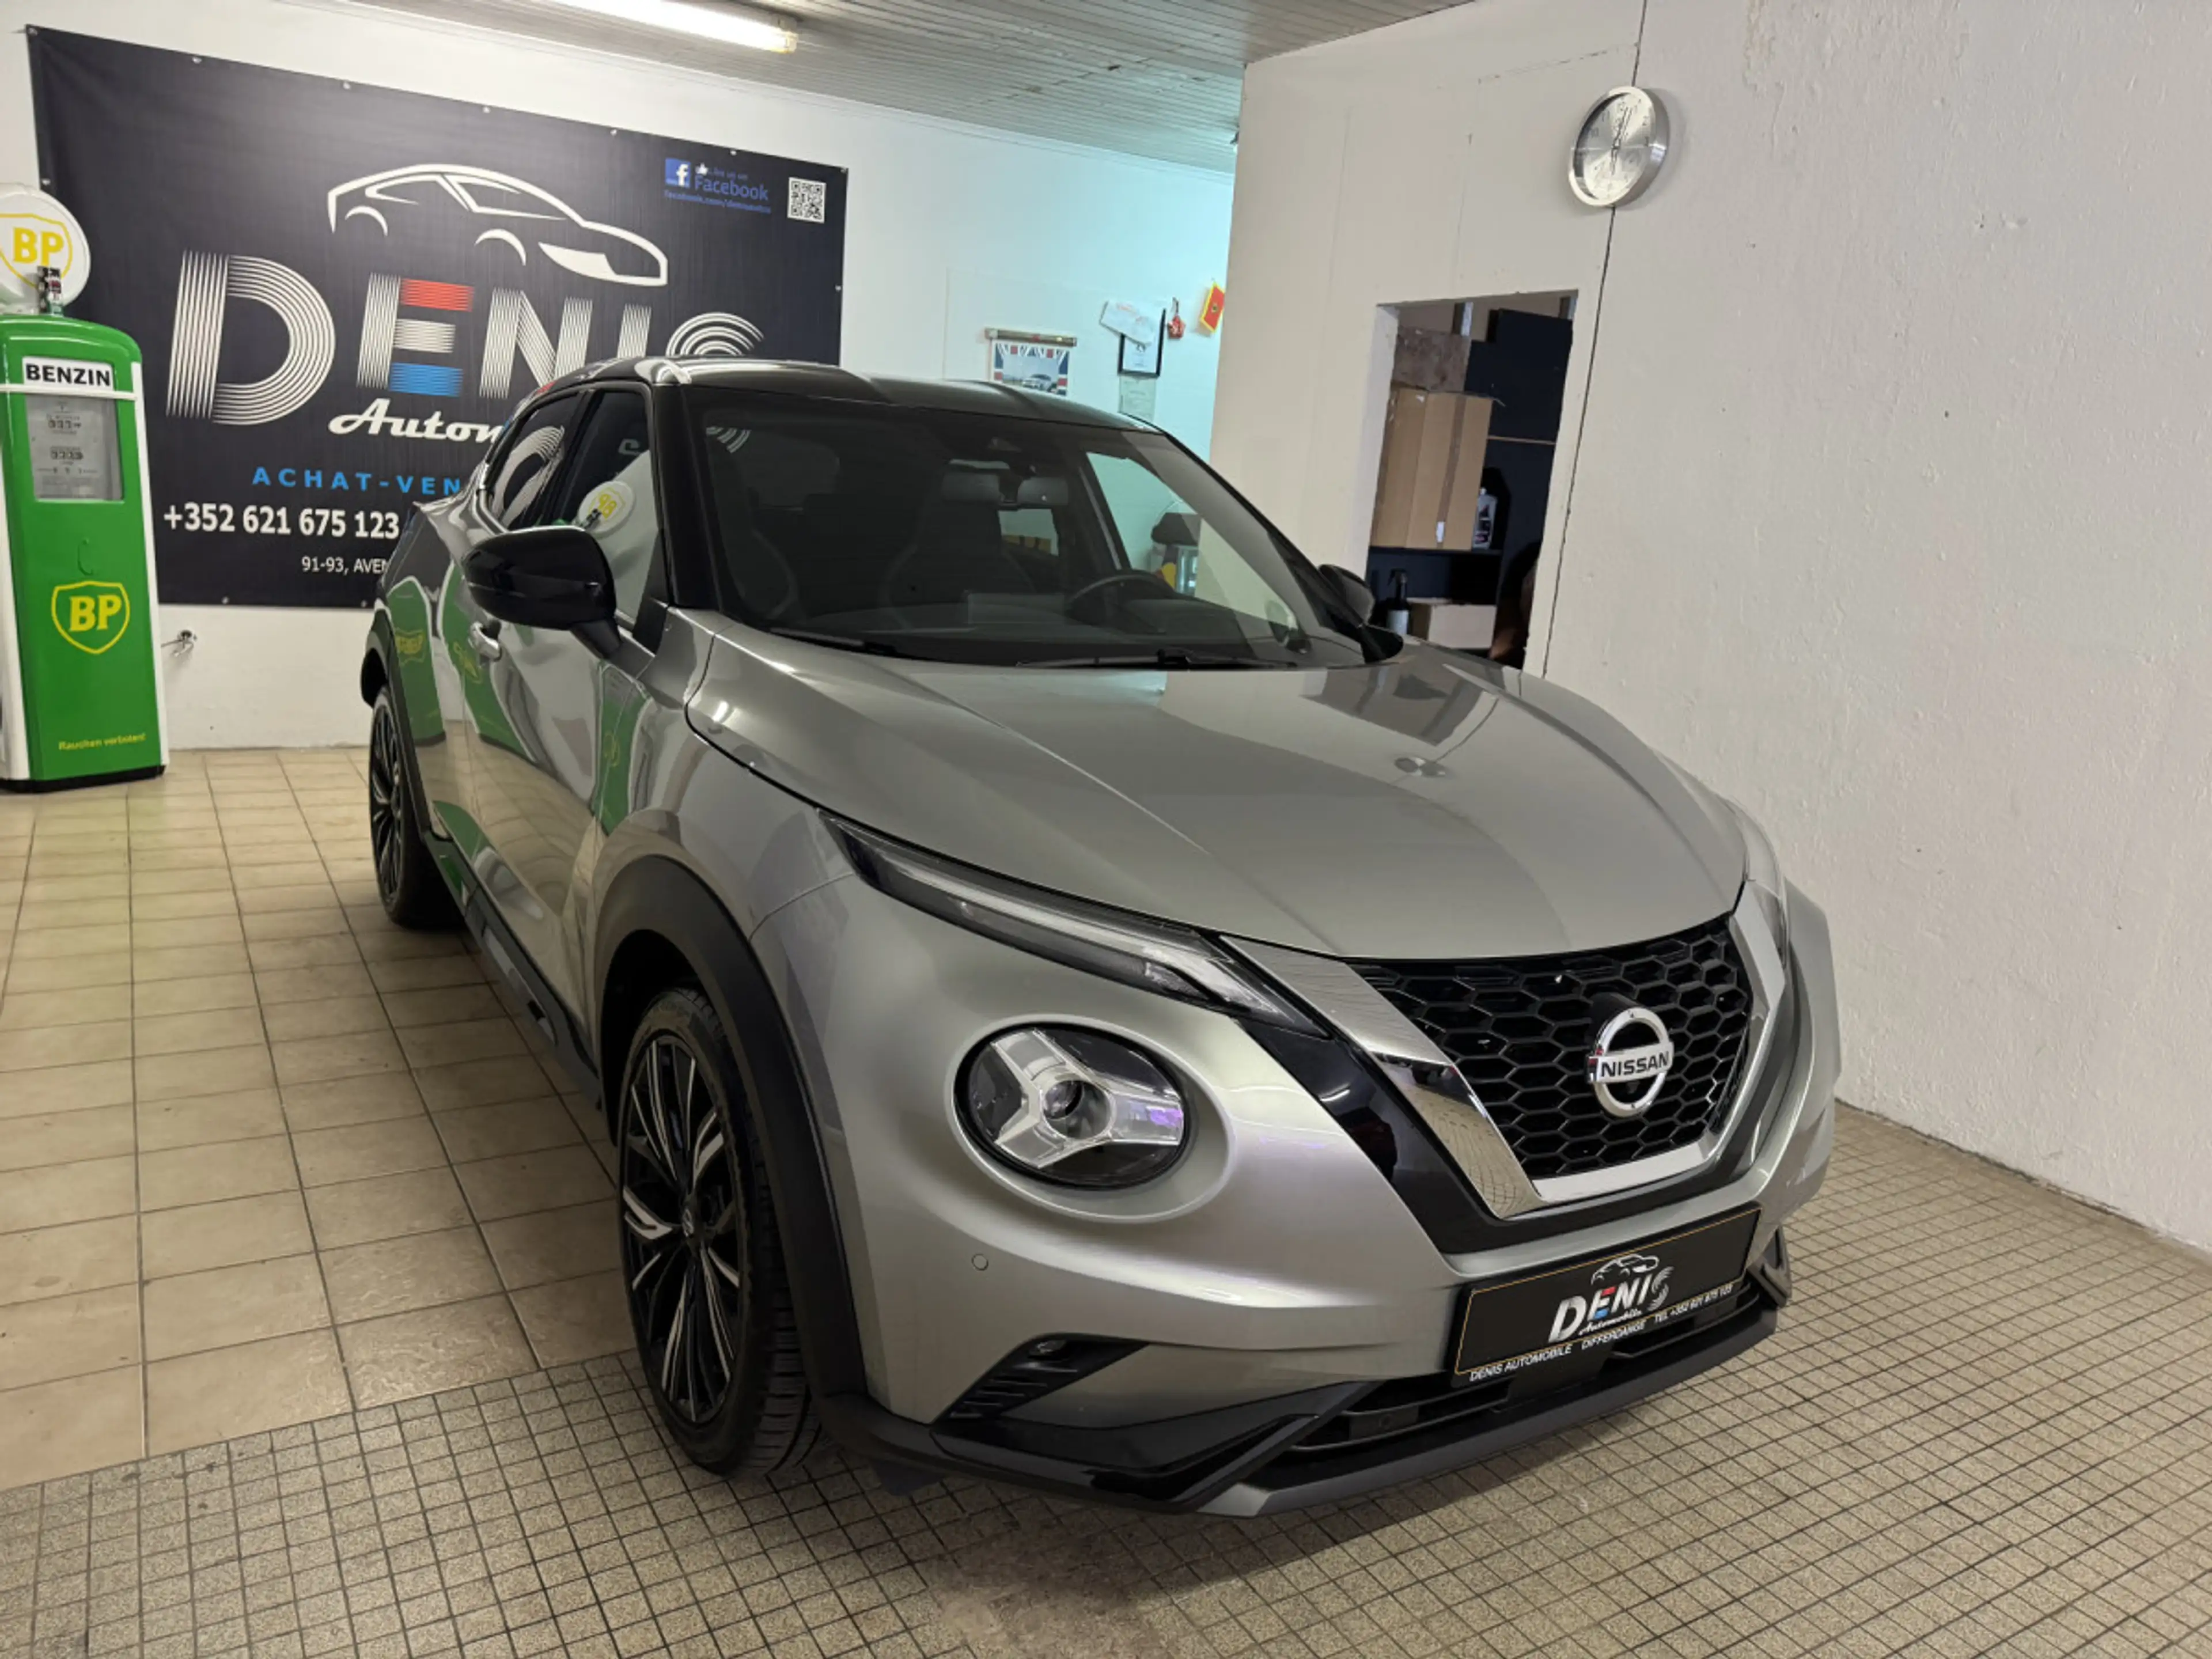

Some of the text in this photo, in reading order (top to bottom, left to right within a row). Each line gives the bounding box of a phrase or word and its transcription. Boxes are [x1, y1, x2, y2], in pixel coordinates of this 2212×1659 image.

[695, 175, 768, 201] Facebook
[13, 227, 65, 267] BP
[26, 363, 111, 387] BENZIN
[252, 467, 461, 496] ACHAT-VEN
[164, 502, 400, 539] +352 621 675 123
[301, 555, 349, 576] 91-93,
[69, 594, 122, 632] BP
[1601, 1051, 1669, 1077] NISSAN
[1548, 1267, 1674, 1343] DENIS
[1469, 1363, 1503, 1382] DENIS
[1504, 1343, 1573, 1373] AUTOMOBILE
